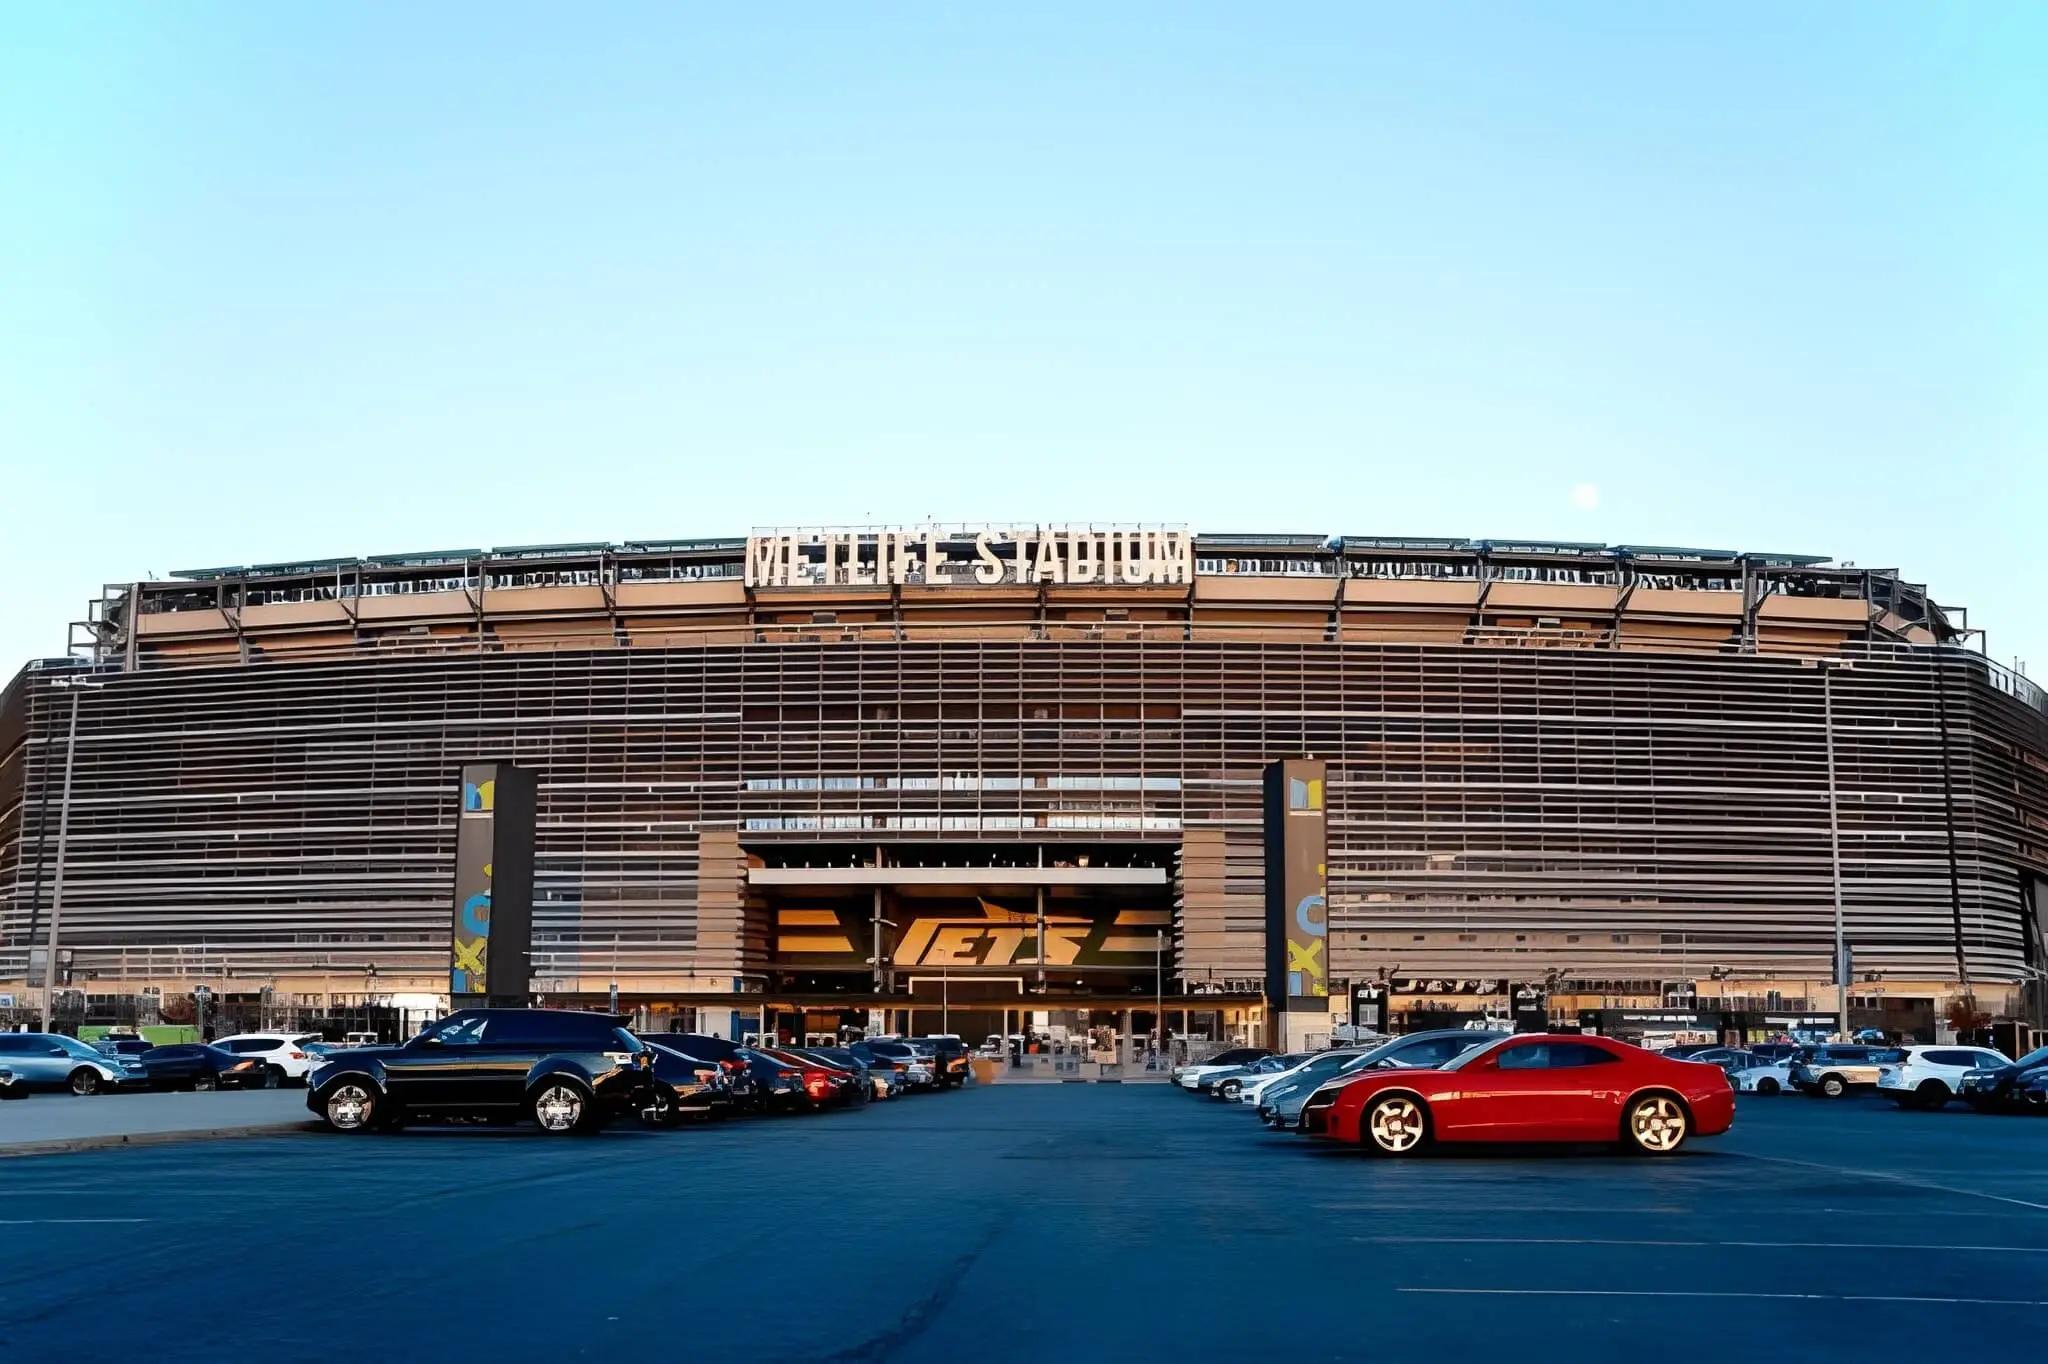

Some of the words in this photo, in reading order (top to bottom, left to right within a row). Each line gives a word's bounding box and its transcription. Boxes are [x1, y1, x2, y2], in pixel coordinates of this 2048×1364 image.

[745, 532, 952, 587] METLIFE
[974, 530, 1193, 584] STADIUM
[893, 896, 1095, 966] JETS
